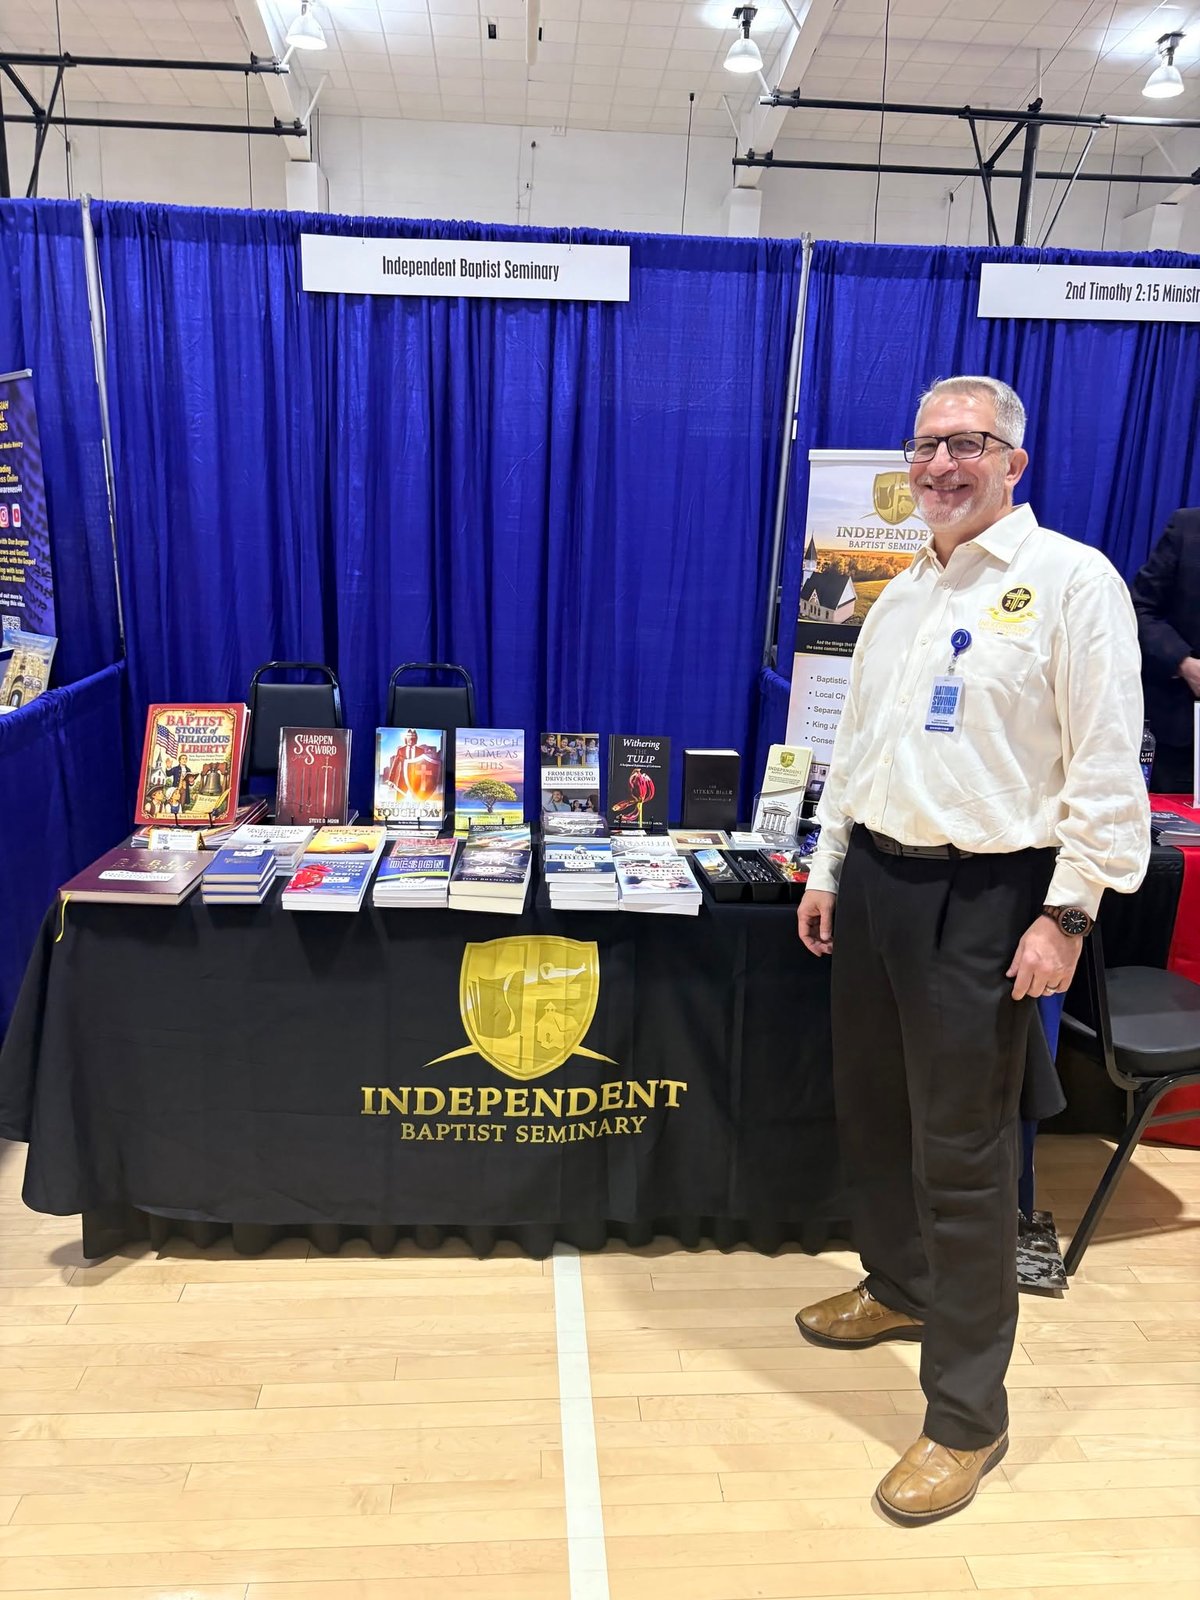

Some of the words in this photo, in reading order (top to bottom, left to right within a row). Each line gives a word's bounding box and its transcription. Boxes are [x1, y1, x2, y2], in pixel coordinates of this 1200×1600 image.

[382, 256, 456, 277] Independent
[460, 258, 501, 279] Baptist
[504, 260, 560, 282] Seminary
[1065, 281, 1086, 300] 2nd
[1090, 282, 1133, 303] Timothy
[1135, 283, 1160, 302] 2:15
[848, 540, 885, 549] BAPTIST
[816, 676, 847, 686] Baptistic
[815, 691, 834, 699] Local
[932, 696, 957, 707] SWORD
[166, 715, 225, 727] BAPTIST
[812, 722, 828, 730] King
[209, 727, 218, 735] of
[177, 735, 230, 744] RELIGIOUS
[294, 735, 333, 754] SHARPEN
[464, 738, 487, 747] FOR
[490, 738, 519, 747] SUCH
[622, 738, 660, 750] Withering
[181, 744, 229, 754] LIBERTY
[305, 745, 336, 765] SWORD
[464, 750, 473, 759] A
[475, 750, 502, 759] TIME
[505, 750, 518, 759] AS
[627, 755, 655, 763] TULIP
[479, 762, 504, 770] THIS
[420, 808, 442, 818] DAY
[390, 860, 444, 869] DESIGN
[361, 1079, 688, 1118] INDEPENDENT
[401, 1122, 507, 1142] BAPTIST
[516, 1115, 647, 1144] SEMINARY
